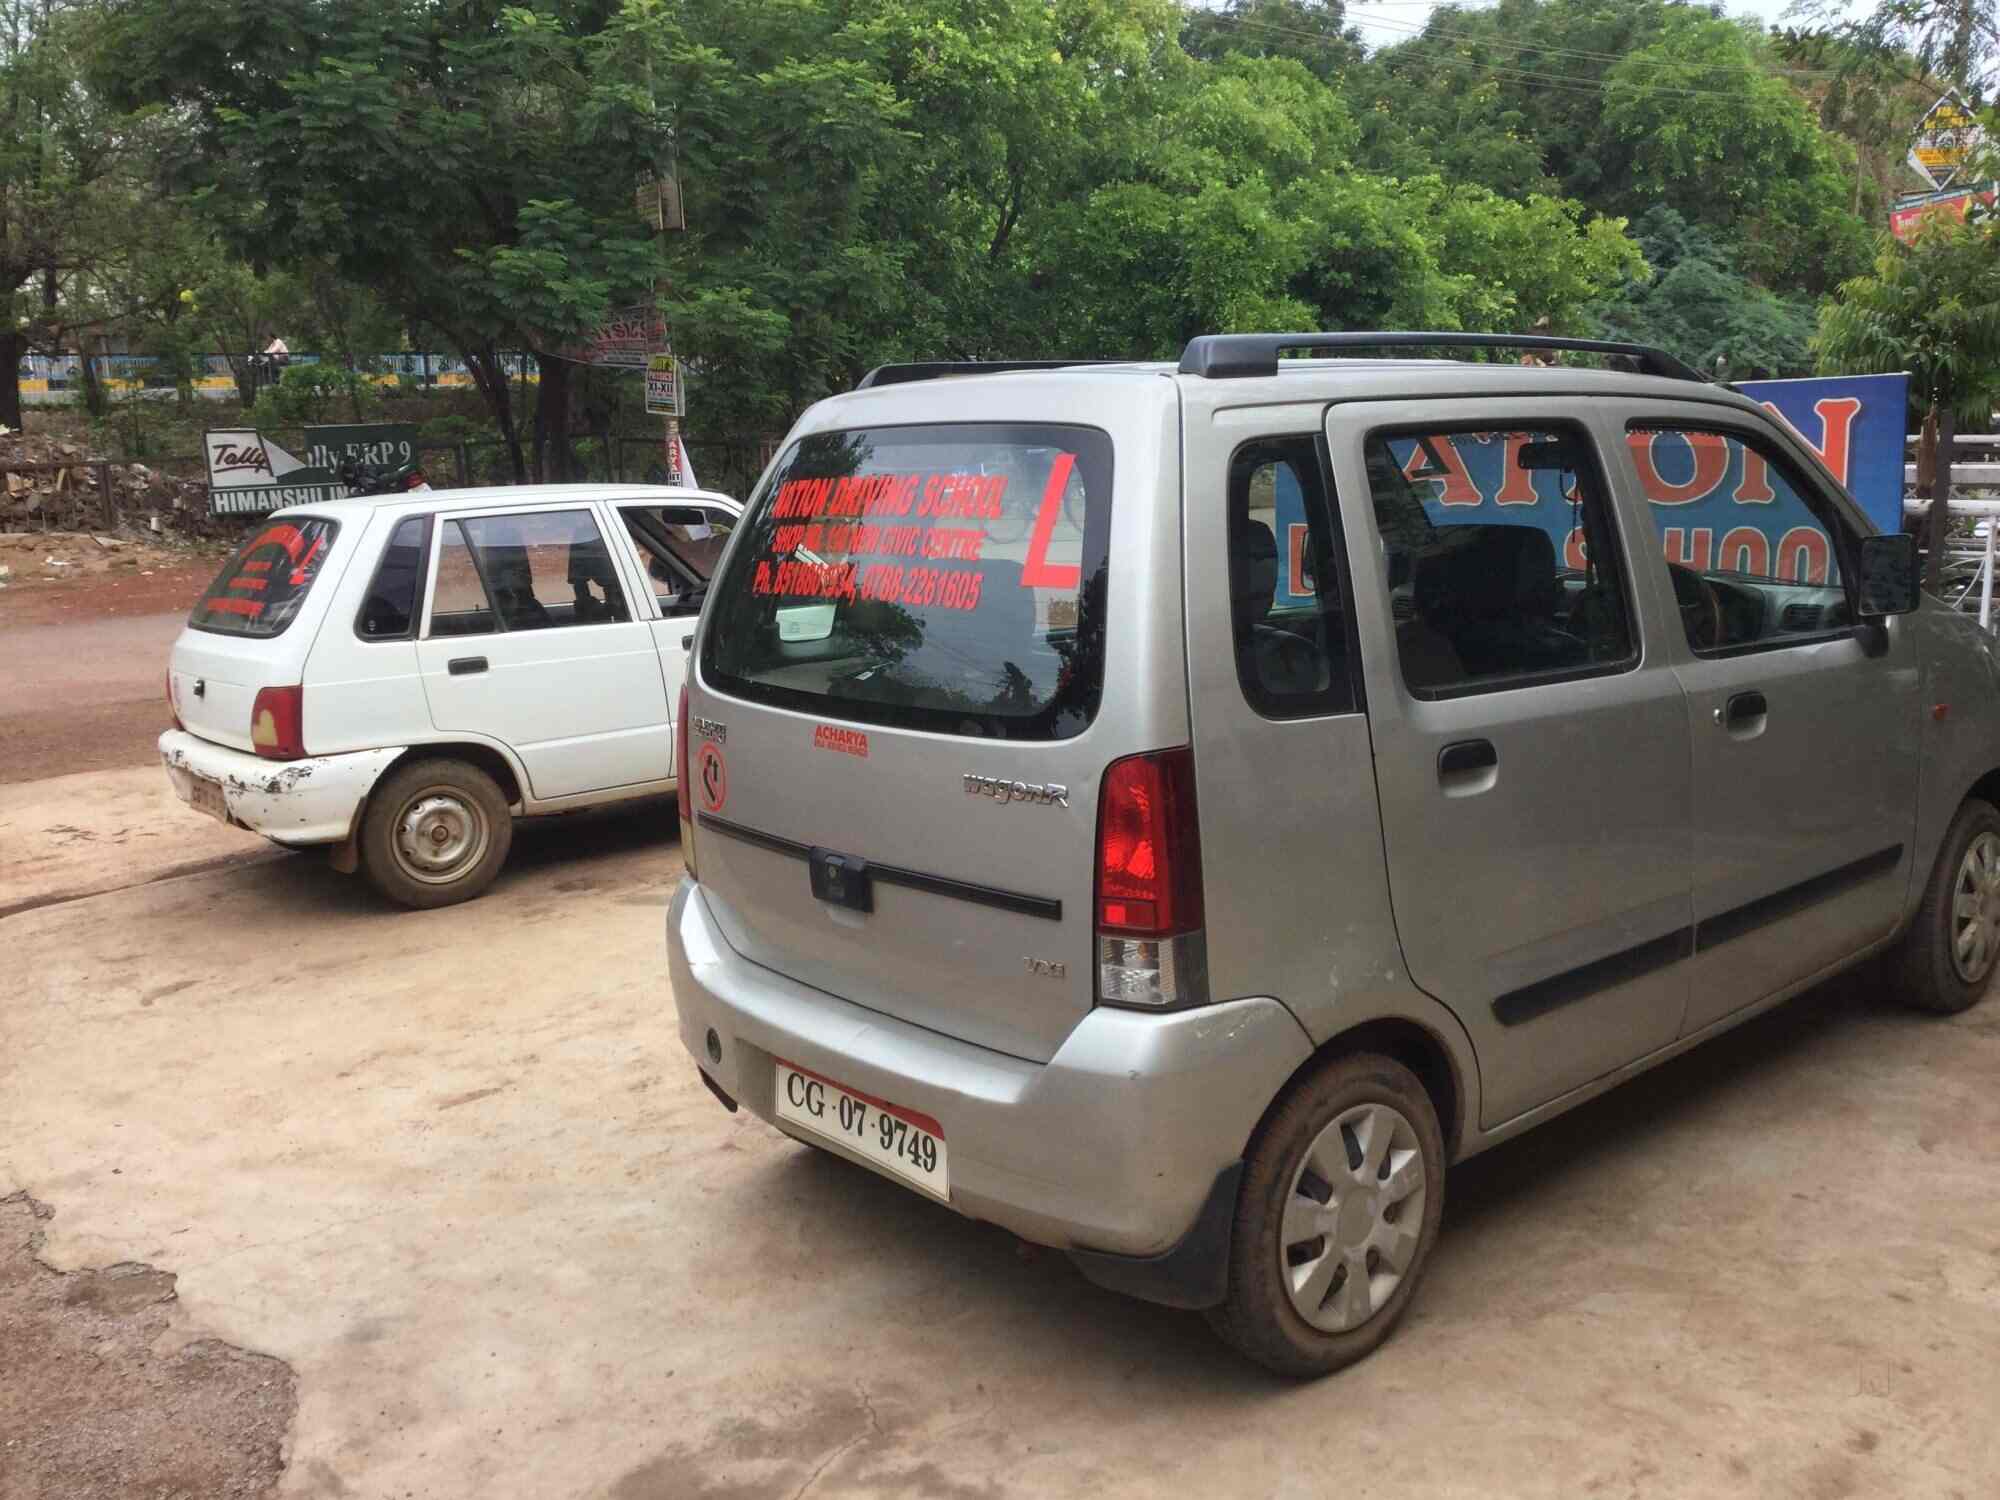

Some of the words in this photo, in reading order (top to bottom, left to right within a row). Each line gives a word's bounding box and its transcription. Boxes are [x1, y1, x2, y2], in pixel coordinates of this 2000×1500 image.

[213, 444, 268, 474] Tally
[398, 441, 411, 464] 9
[828, 474, 920, 517] DRIVING
[916, 474, 1009, 519] SCHOOL
[1020, 453, 1082, 588] L
[815, 724, 867, 747] ACHARYA
[879, 1113, 937, 1173] 9749
